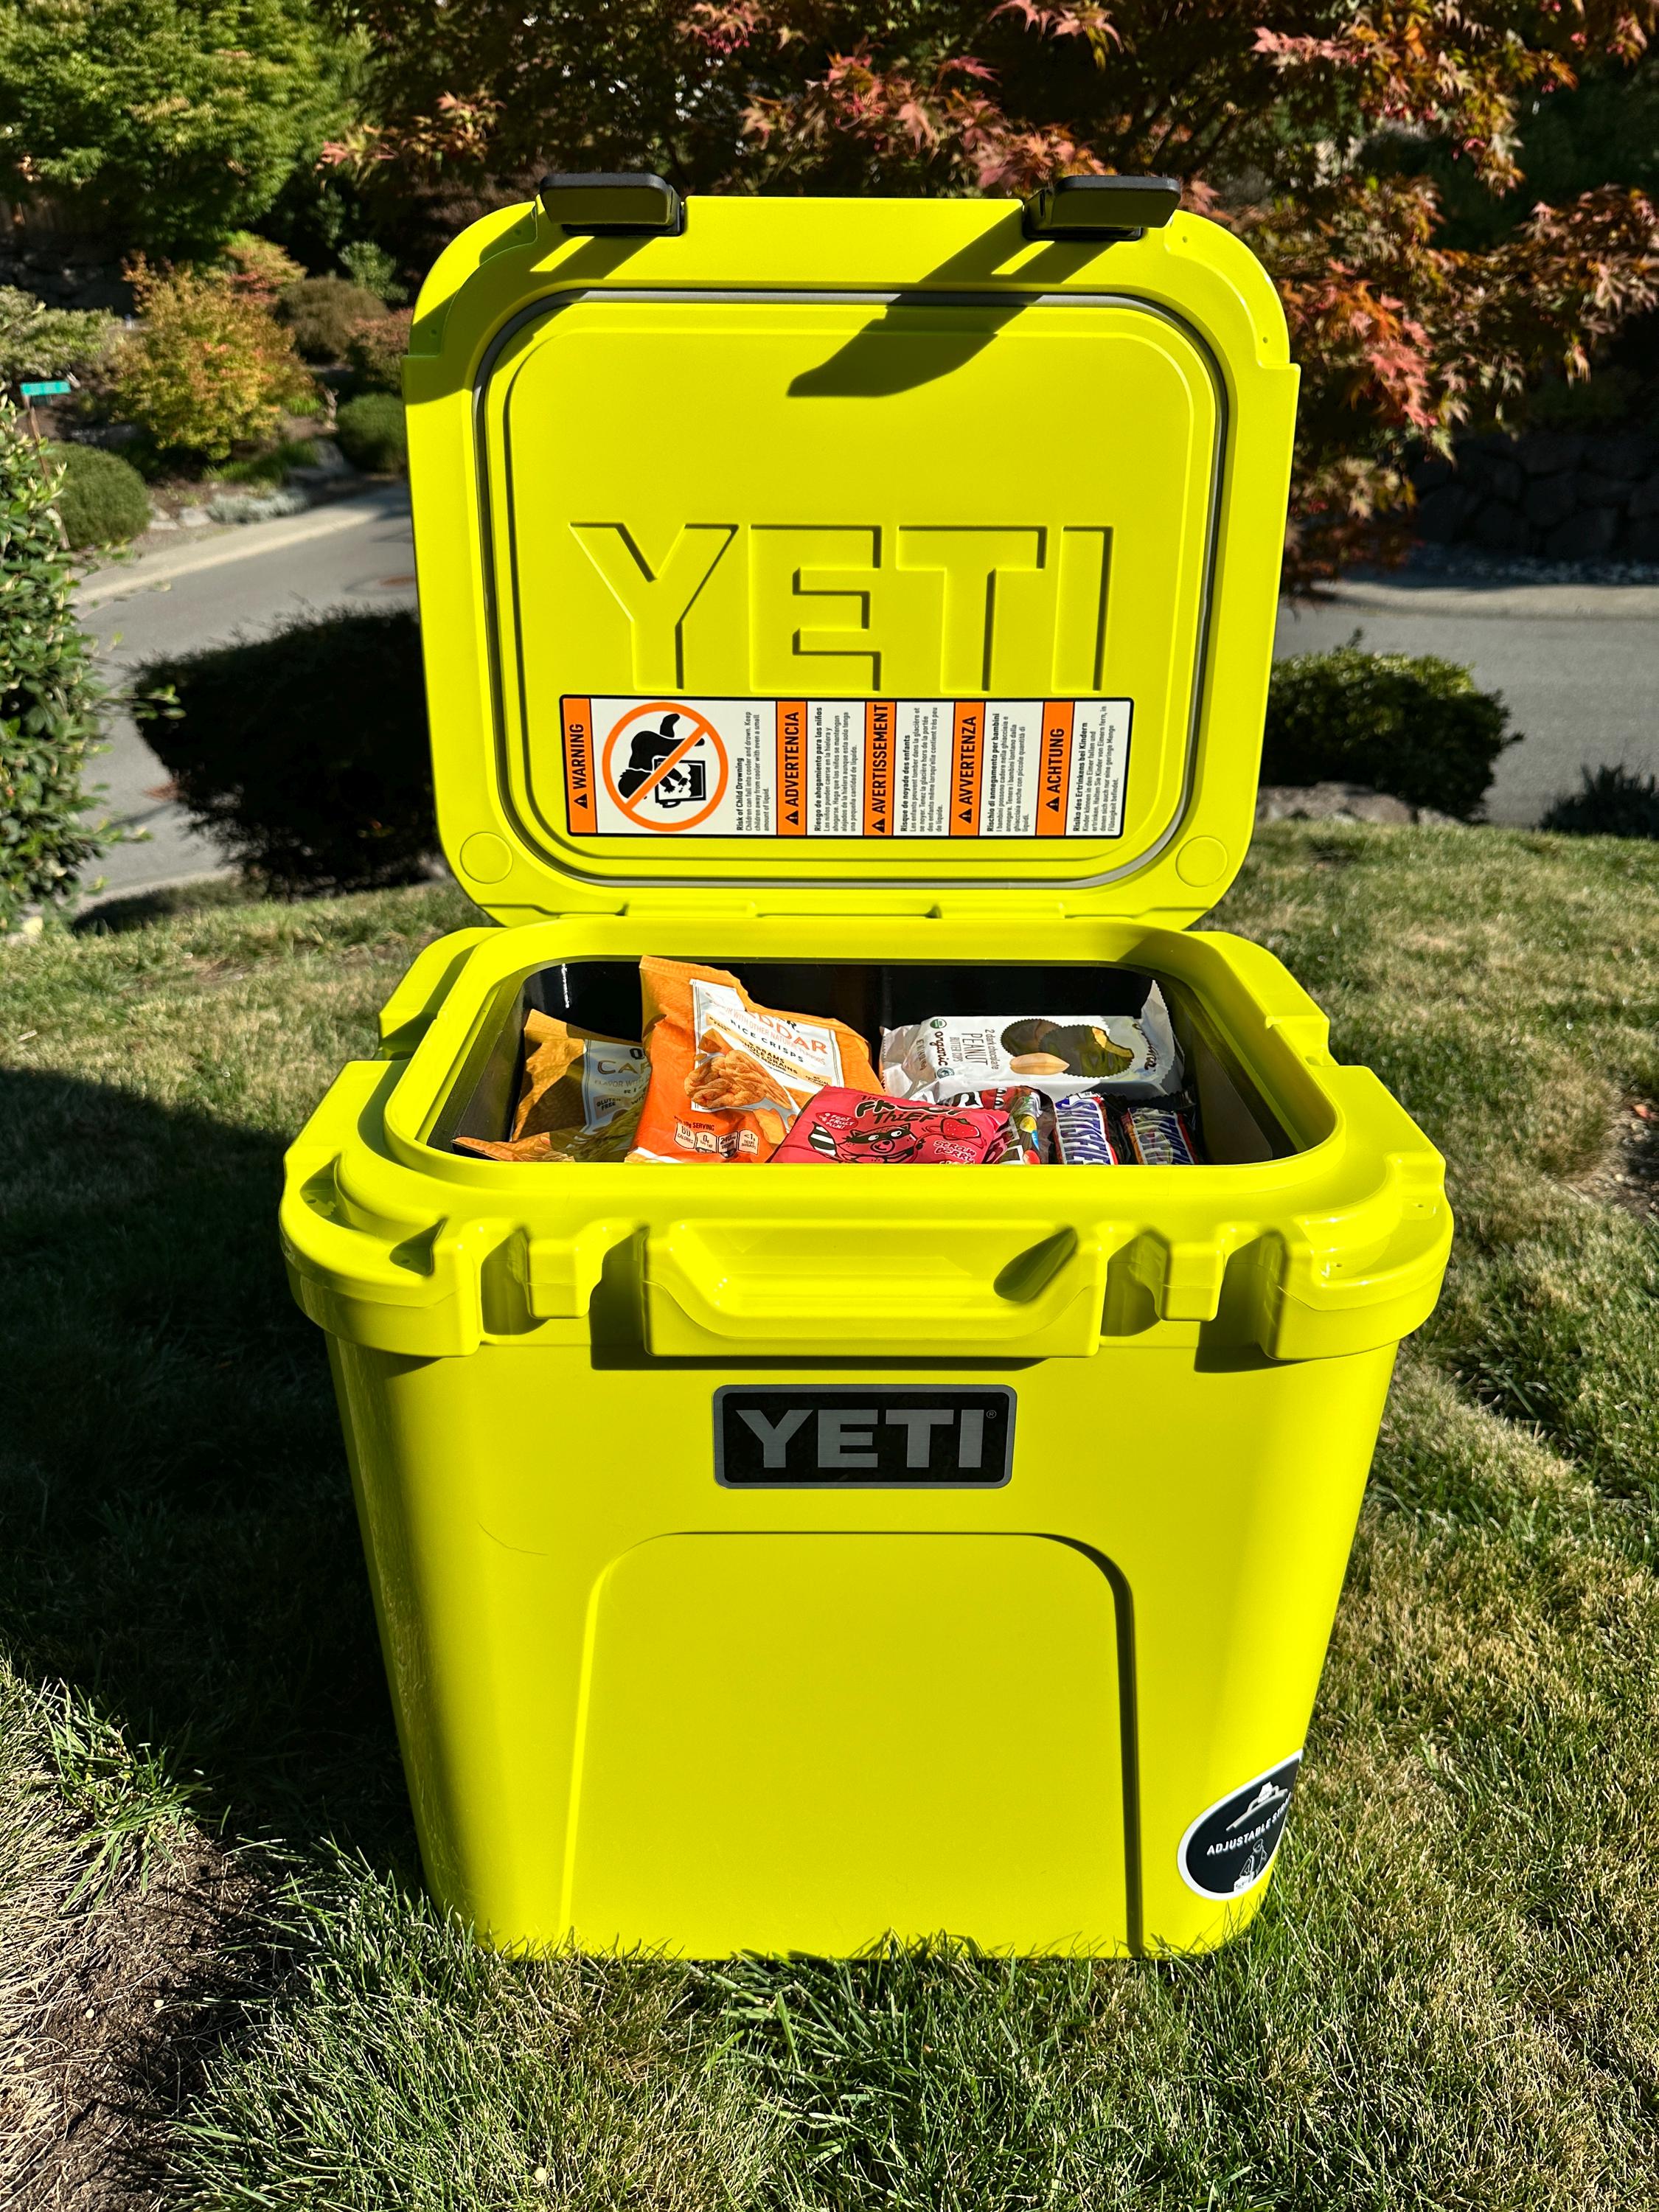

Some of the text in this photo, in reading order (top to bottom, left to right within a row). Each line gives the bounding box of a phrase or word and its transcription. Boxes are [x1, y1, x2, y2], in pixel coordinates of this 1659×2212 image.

[568, 522, 1113, 694] YETI
[991, 713, 999, 740] bambini
[1079, 723, 1088, 749] Kindern
[569, 724, 587, 790] WARNING
[785, 712, 799, 807] ADVERTENCIA
[872, 704, 888, 815] AVERTISSEMENT
[959, 716, 976, 805] AVVERTENZA
[1046, 728, 1064, 793] ACHTUNG
[736, 757, 745, 789] Drowning
[814, 755, 823, 799] ahogamiento
[902, 775, 911, 799] noyade
[990, 754, 999, 799] annegamento
[1076, 762, 1085, 797] Ertrinkens
[814, 799, 821, 807] de
[901, 800, 908, 808] de
[1074, 798, 1082, 810] des
[814, 809, 823, 832] Riesgo
[900, 810, 909, 832] Risque
[987, 807, 995, 832] Rischio
[1073, 811, 1082, 832] Risiko
[761, 1037, 804, 1062] CRISPS
[930, 1032, 949, 1066] organic
[961, 1033, 988, 1065] PEANUT
[985, 1034, 996, 1046] dark
[988, 1046, 1001, 1070] chocolate
[693, 1122, 715, 1131] SERVING
[1056, 1100, 1111, 1164] SATISFIE
[1207, 1818, 1271, 1857] ADJUSTABLE
